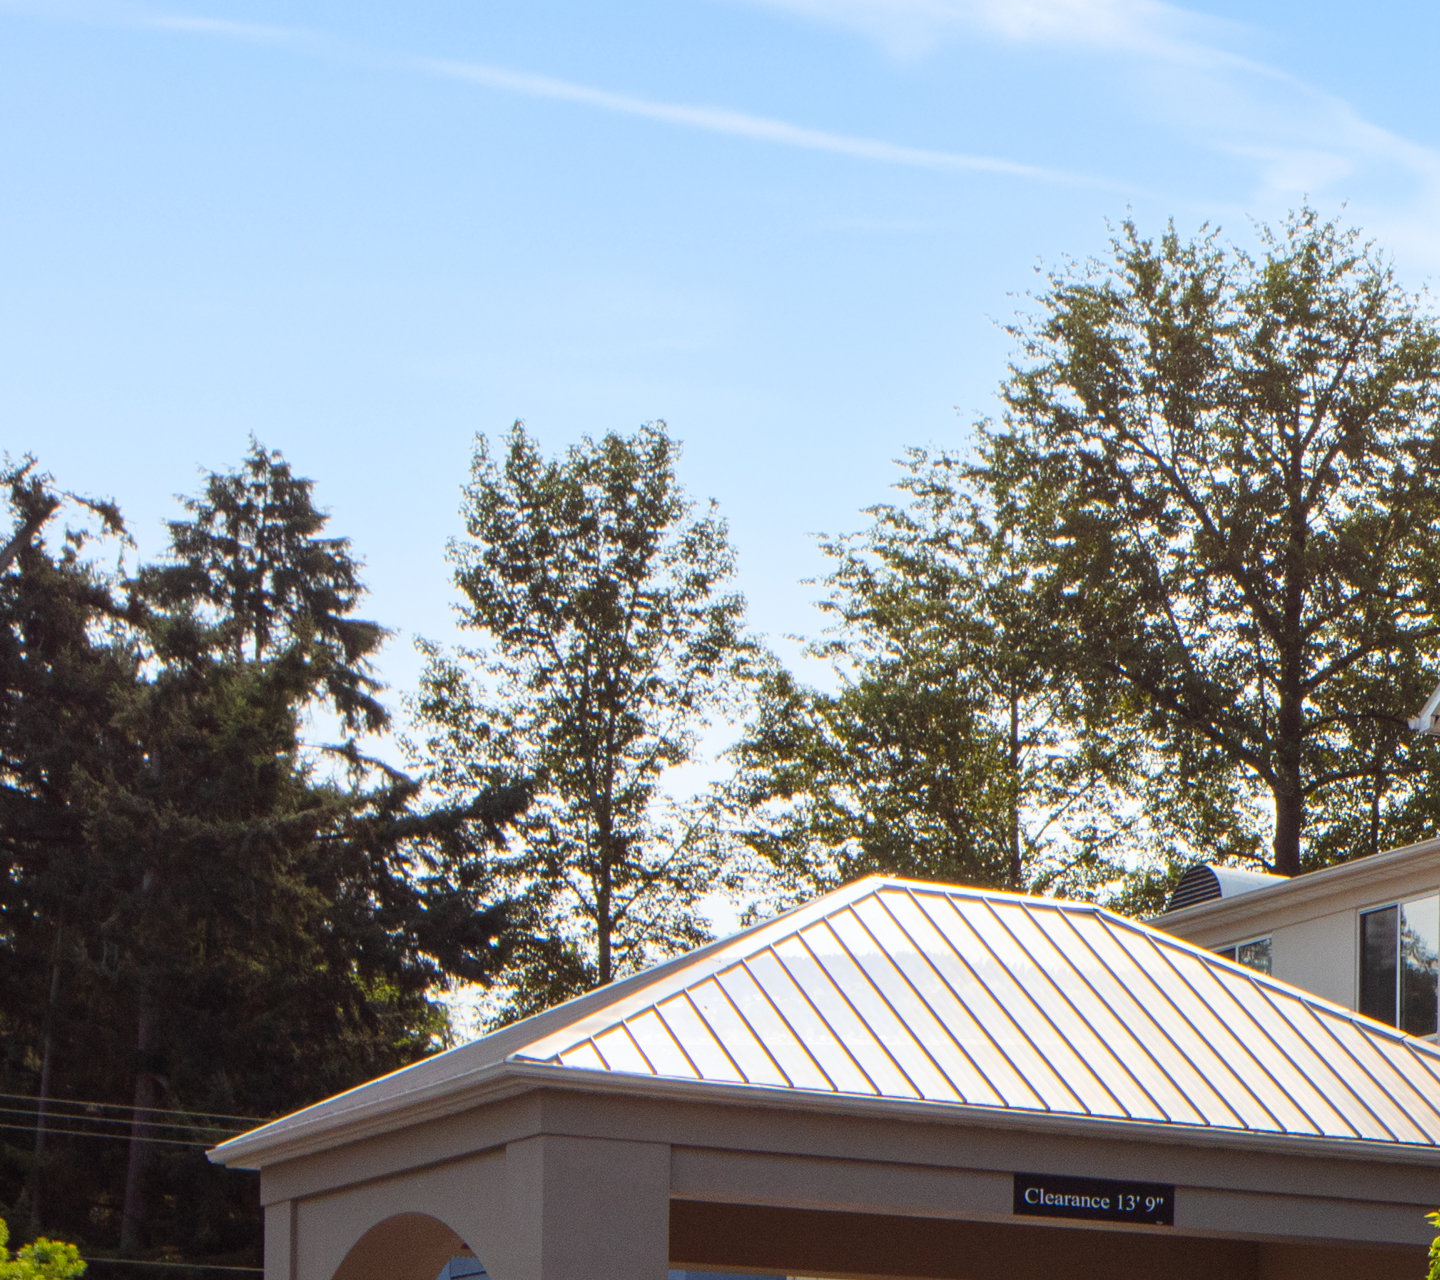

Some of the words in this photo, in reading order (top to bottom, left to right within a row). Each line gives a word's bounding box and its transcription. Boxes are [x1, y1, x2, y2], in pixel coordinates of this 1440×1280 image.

[1024, 1187, 1110, 1210] Clearance
[1117, 1194, 1140, 1211] 13'
[1145, 1196, 1163, 1212] 9"
